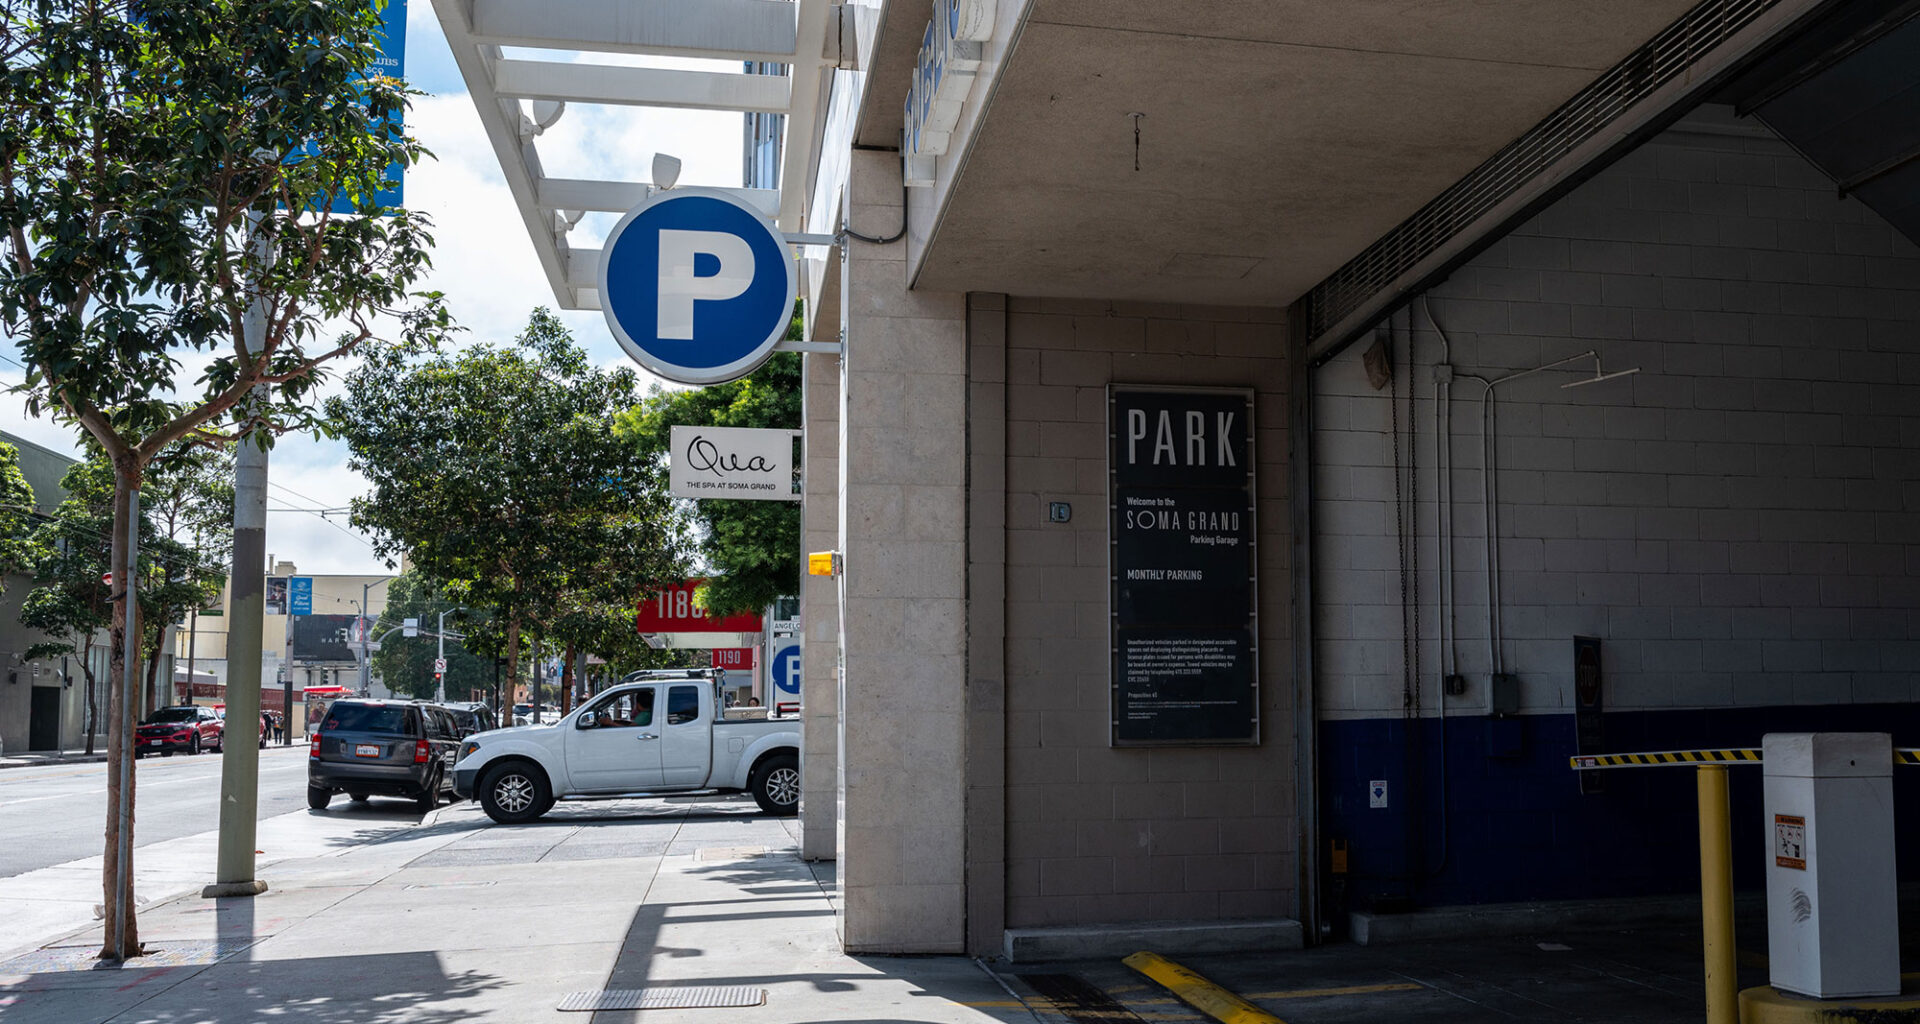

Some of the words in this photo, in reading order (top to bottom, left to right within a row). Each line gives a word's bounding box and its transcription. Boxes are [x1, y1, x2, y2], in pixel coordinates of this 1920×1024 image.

[657, 229, 755, 340] P
[1128, 408, 1237, 467] PARK
[687, 435, 776, 477] Qua
[687, 481, 701, 489] THE
[702, 481, 716, 489] SPA
[728, 482, 749, 490] SOMA
[1127, 496, 1156, 506] Welcome
[1157, 497, 1163, 506] to
[1164, 497, 1175, 506] the
[1127, 510, 1181, 530] SOMA
[1188, 511, 1239, 531] GRAND
[1190, 535, 1215, 546] Parking
[1216, 535, 1239, 546] Garage
[1127, 569, 1165, 580] MONTHLY
[1167, 569, 1202, 580] PARKING
[718, 650, 741, 664] 1190
